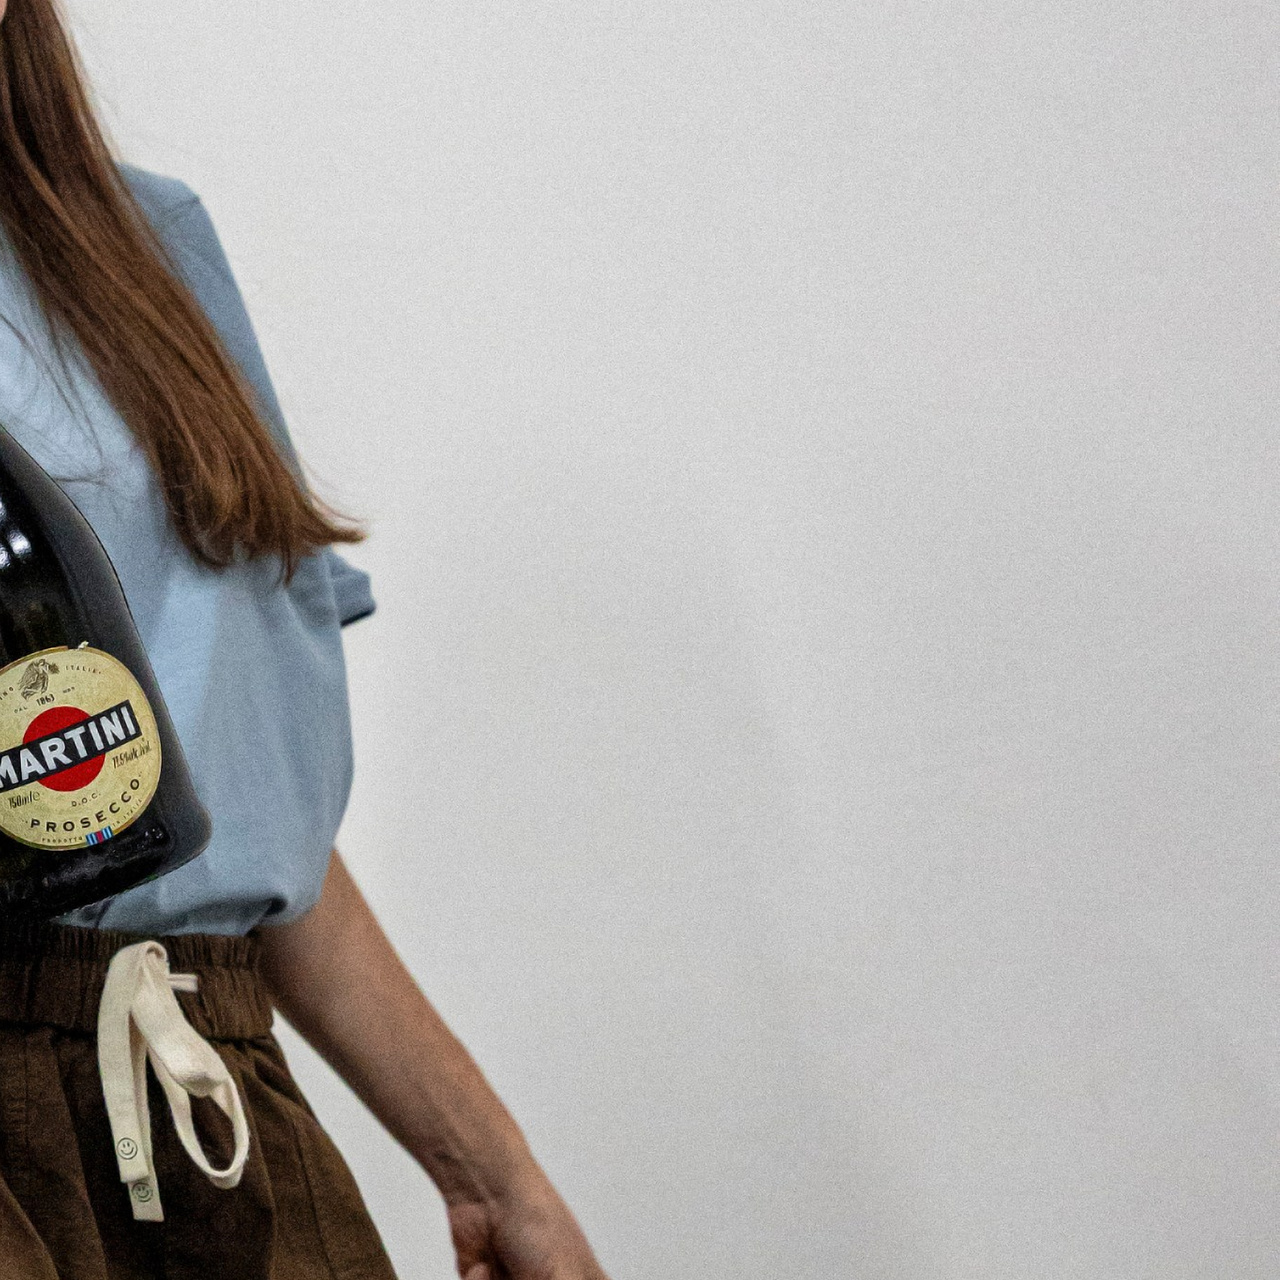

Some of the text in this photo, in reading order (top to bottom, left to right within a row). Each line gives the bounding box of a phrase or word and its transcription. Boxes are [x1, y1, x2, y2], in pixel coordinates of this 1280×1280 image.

[64, 664, 99, 674] ITALIA
[35, 693, 56, 707] 1863
[30, 778, 140, 833] PROSECCO
